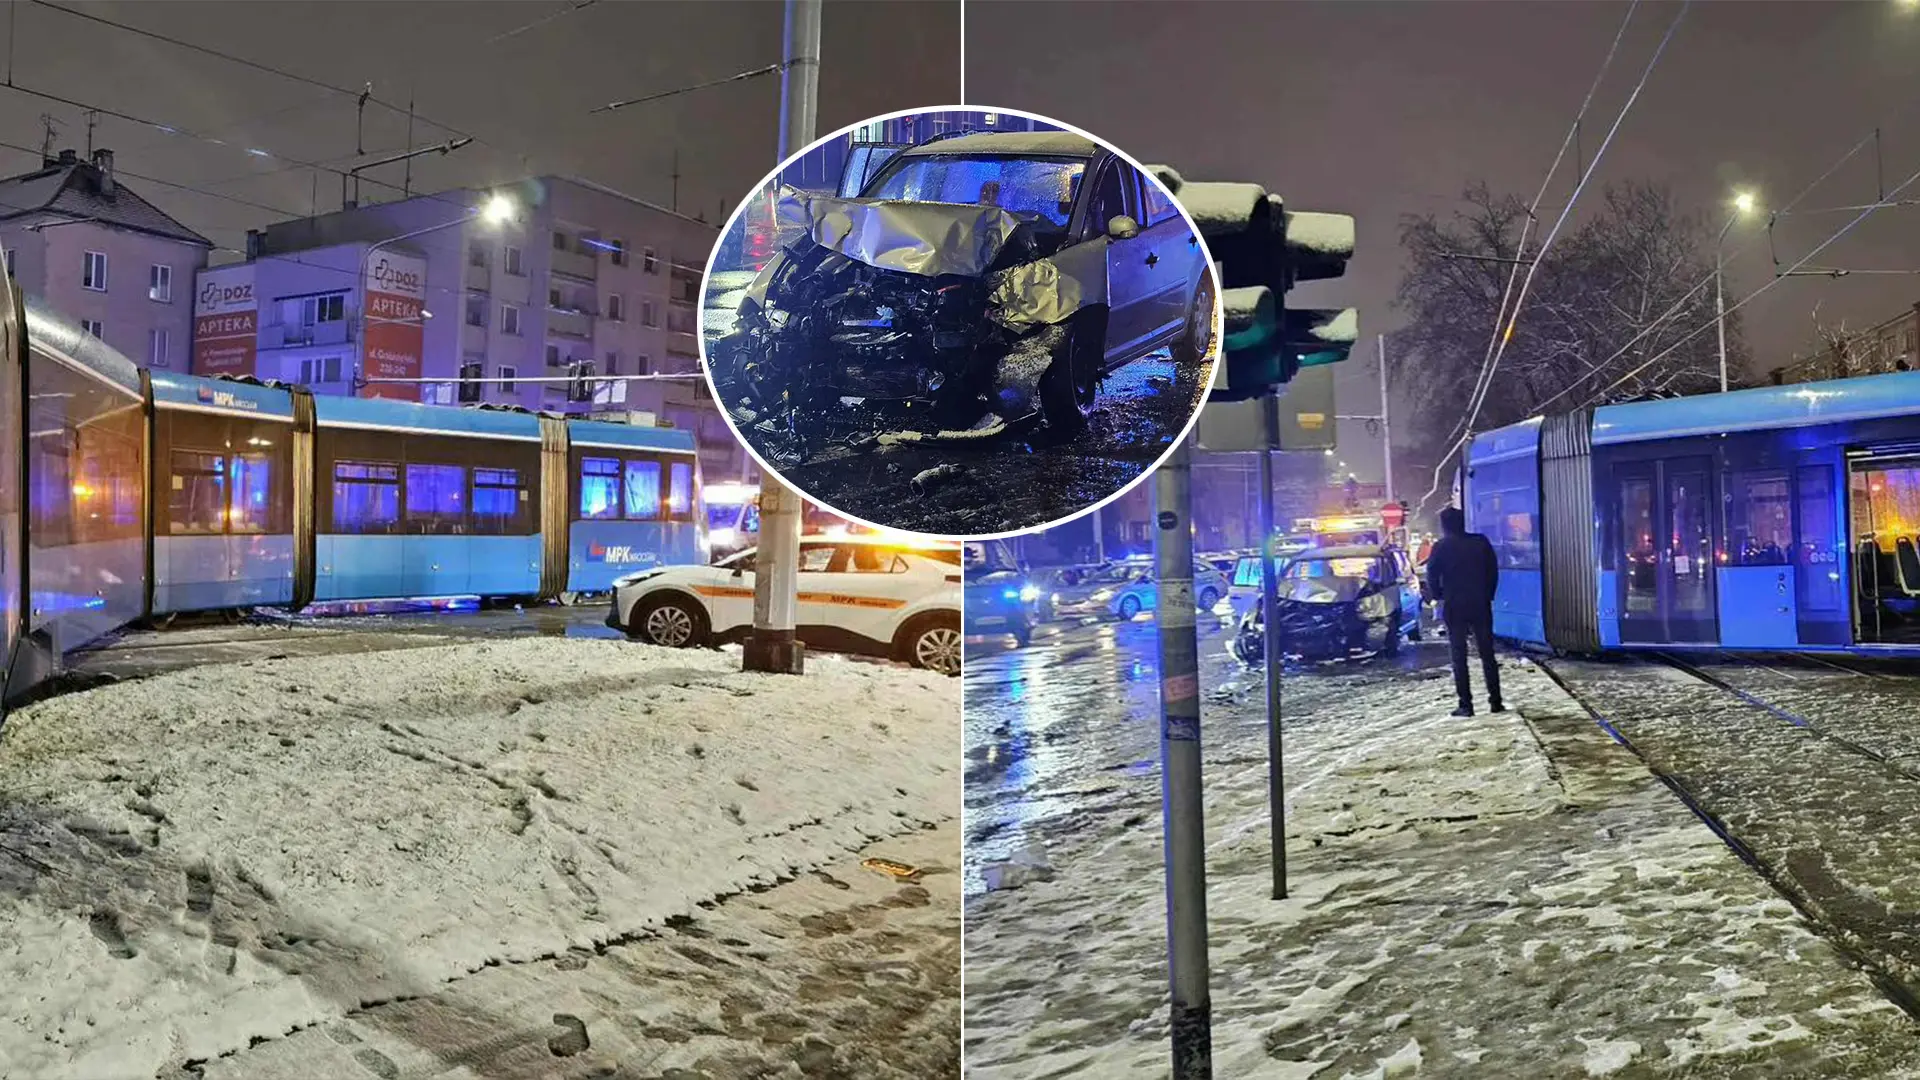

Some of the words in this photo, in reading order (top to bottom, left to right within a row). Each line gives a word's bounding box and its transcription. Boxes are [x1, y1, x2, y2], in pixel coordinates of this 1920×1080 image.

[396, 272, 419, 286] DOZ
[224, 284, 253, 301] DOZ
[371, 298, 419, 318] APTEKA
[198, 315, 253, 335] APTEKA
[213, 391, 235, 408] MPK
[605, 546, 631, 563] MPK
